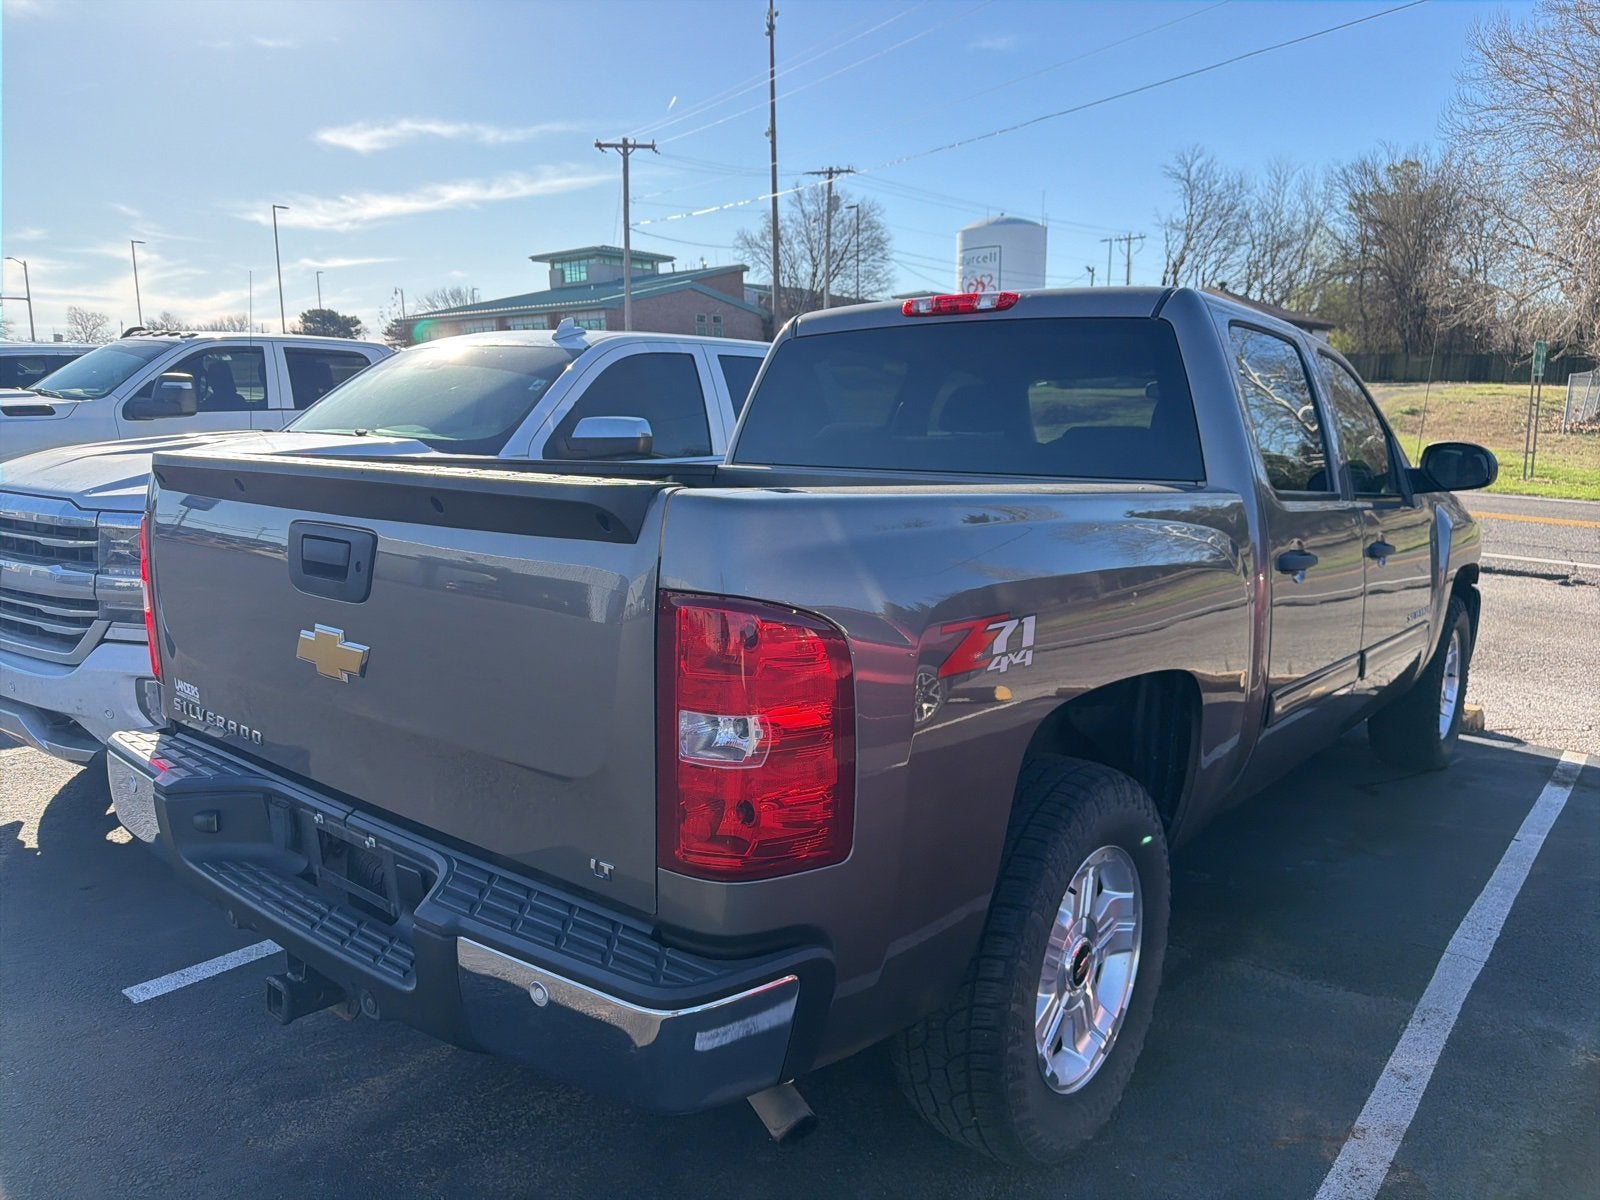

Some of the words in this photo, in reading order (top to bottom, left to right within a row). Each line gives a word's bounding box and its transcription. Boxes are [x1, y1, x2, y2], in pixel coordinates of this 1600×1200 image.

[938, 613, 1036, 678] Z71
[174, 698, 262, 744] SILVERADO
[590, 858, 615, 878] LT
